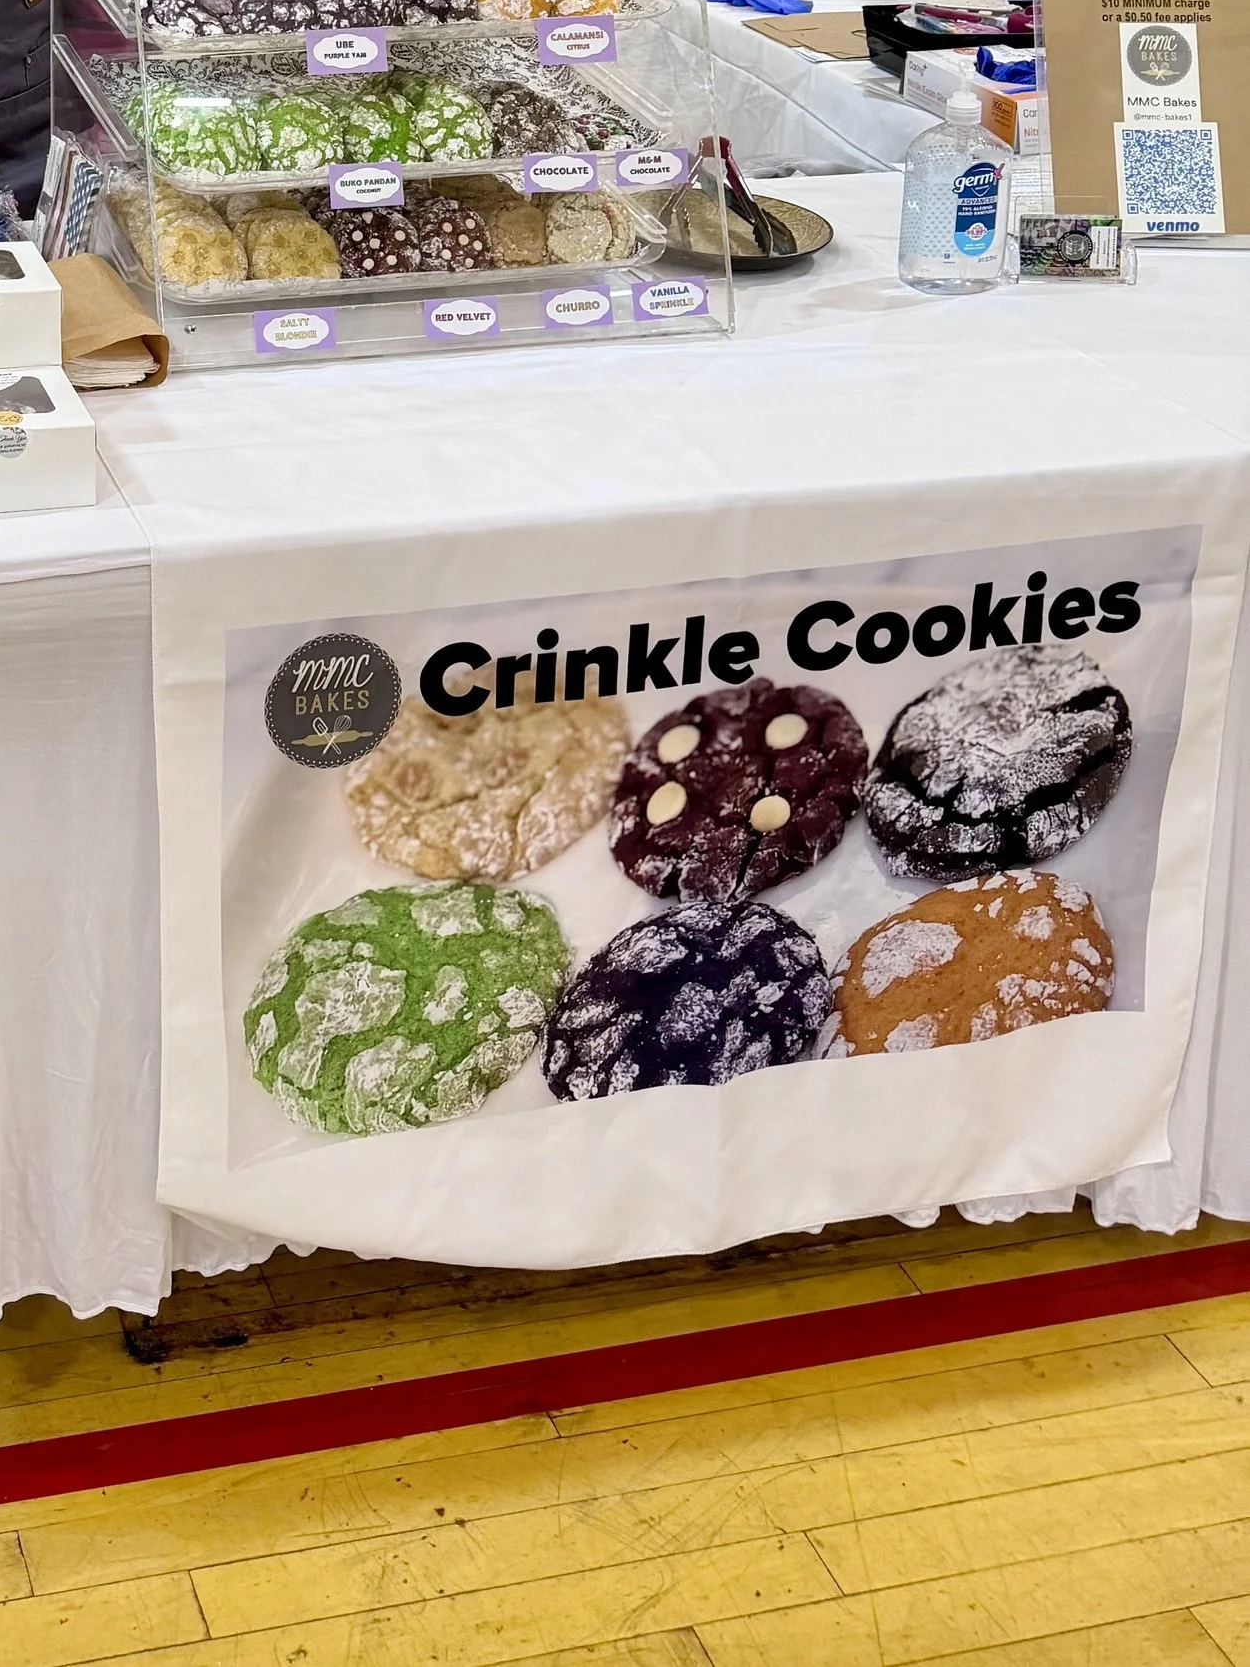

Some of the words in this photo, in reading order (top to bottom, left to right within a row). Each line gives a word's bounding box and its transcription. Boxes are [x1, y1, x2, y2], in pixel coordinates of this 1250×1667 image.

[1102, 14, 1113, 22] or
[1116, 14, 1122, 22] a
[1125, 12, 1152, 23] $0.50
[1155, 12, 1171, 22] fee
[1174, 12, 1212, 24] applies
[550, 30, 604, 43] CALAMANSI
[335, 40, 355, 49] UBE
[1141, 52, 1177, 61] BAKES
[1127, 96, 1160, 107] MMC
[1163, 97, 1197, 107] Bakes
[638, 155, 662, 165] M&M
[533, 167, 589, 177] CHOCOLATE
[630, 166, 671, 175] CHOCOLATE
[340, 179, 362, 188] BUKO
[363, 177, 397, 187] PANDAN
[1147, 220, 1200, 232] venmo
[650, 285, 690, 298] VANILLA
[555, 300, 601, 314] CHURRO
[649, 298, 695, 311] SPRINKLE
[435, 313, 454, 323] RED
[456, 311, 492, 323] VELVET
[418, 615, 760, 717] Crinkle
[785, 570, 1143, 672] Cookies
[295, 690, 370, 716] BAKES
